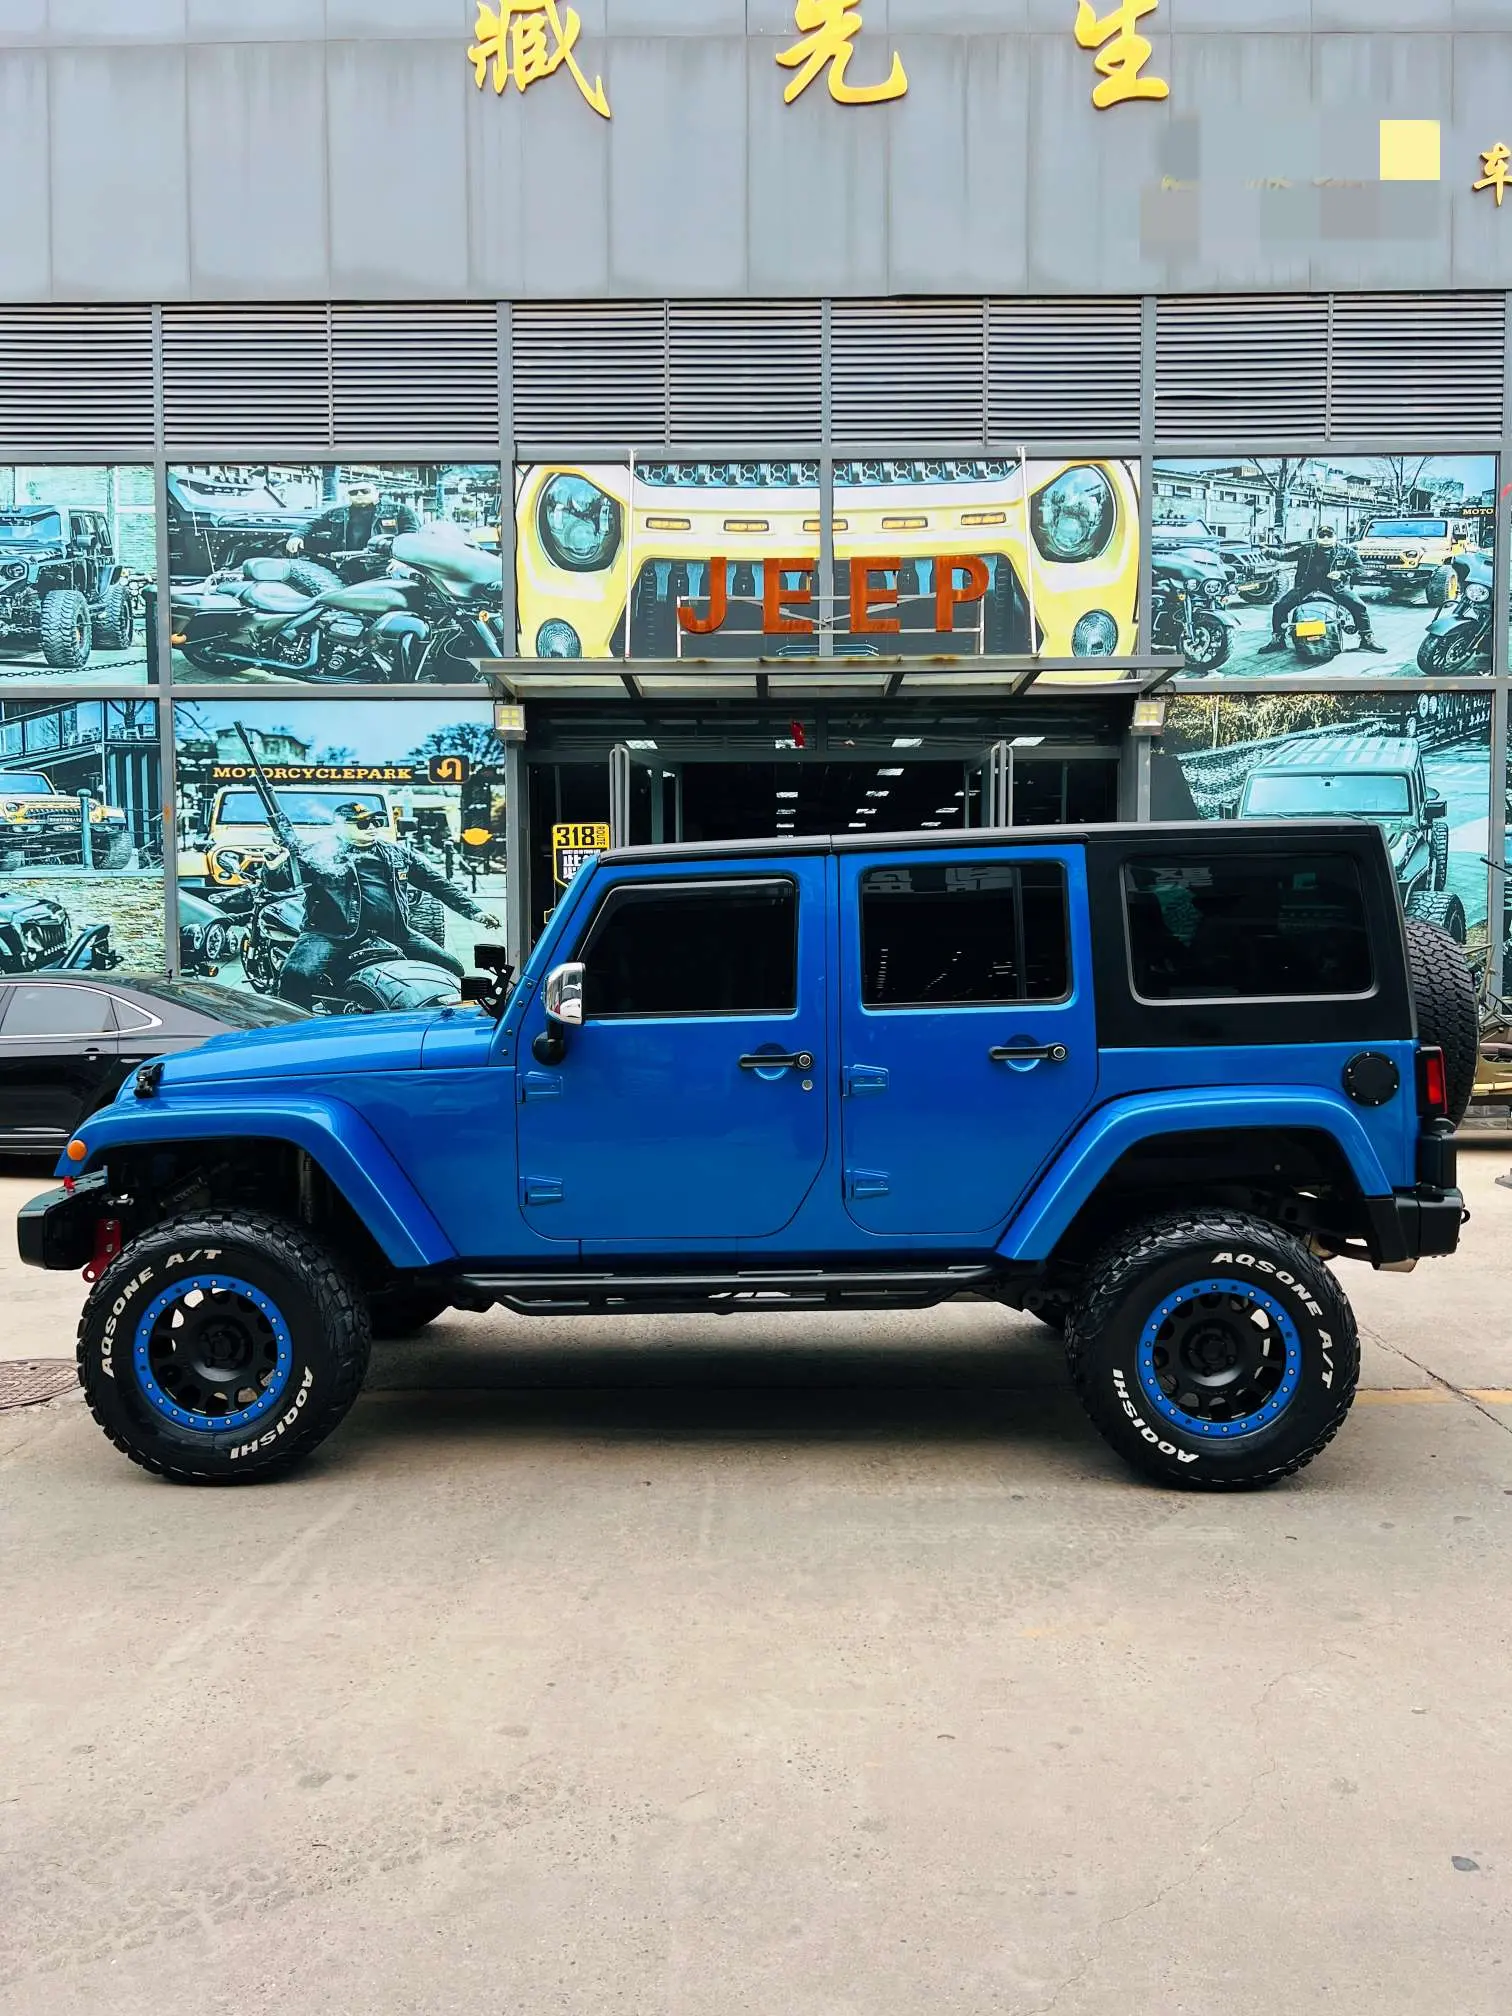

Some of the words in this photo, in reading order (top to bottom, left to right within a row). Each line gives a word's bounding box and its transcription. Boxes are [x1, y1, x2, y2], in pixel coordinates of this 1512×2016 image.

[672, 556, 990, 634] JEEP
[212, 766, 412, 780] MOTORCYCLEPARK
[556, 826, 595, 846] 318
[101, 1266, 154, 1378] AQSONE
[165, 1249, 222, 1268] A/T
[1212, 1252, 1323, 1317] AQSONE
[1318, 1328, 1335, 1389] A/T
[229, 1366, 313, 1460] AOQISHI
[1112, 1368, 1200, 1463] AOQISHI
